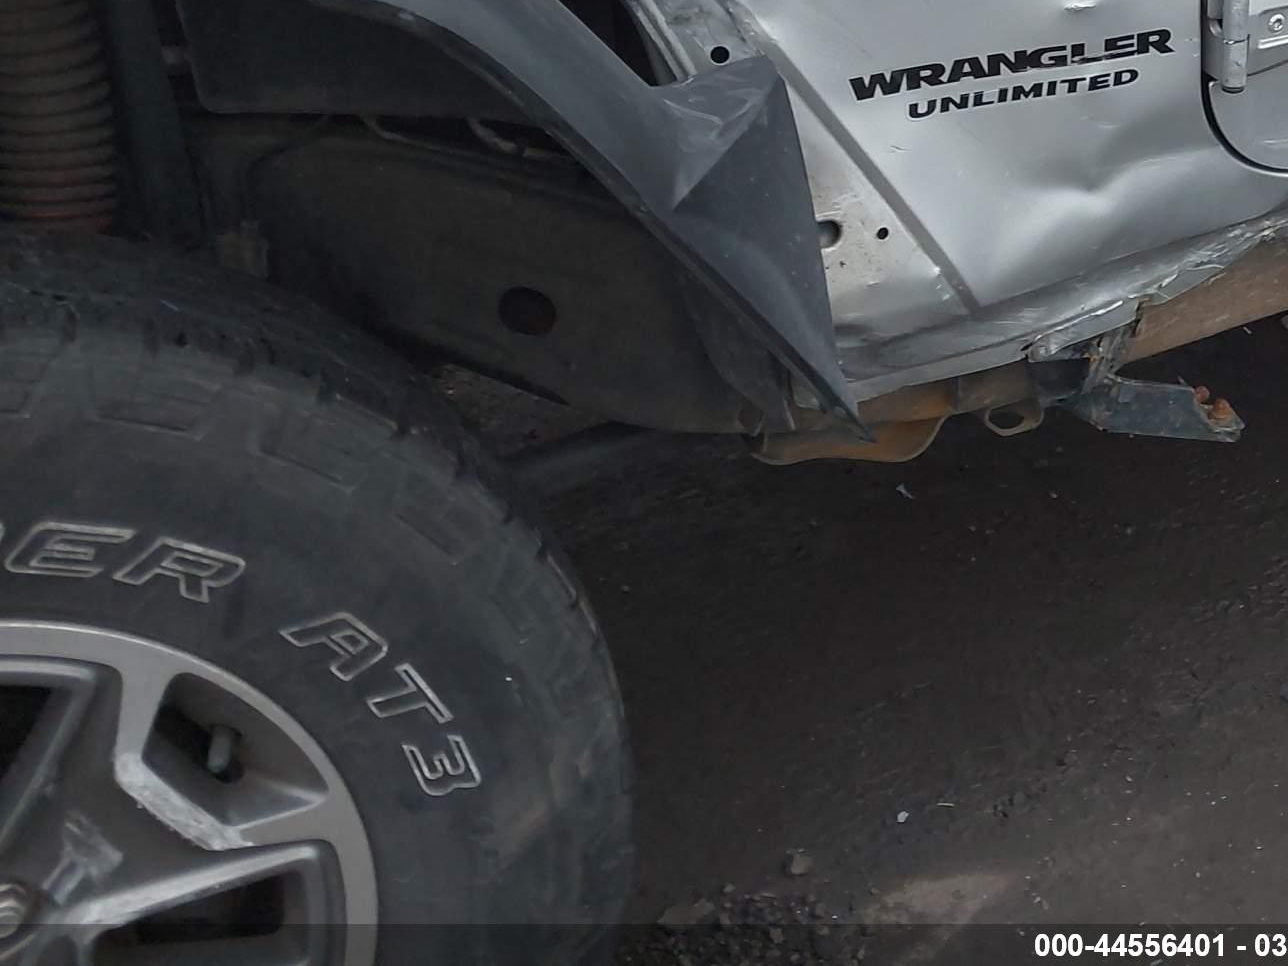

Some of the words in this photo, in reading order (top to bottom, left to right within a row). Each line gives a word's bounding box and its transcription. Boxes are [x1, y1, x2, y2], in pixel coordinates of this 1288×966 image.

[849, 29, 1175, 101] WRANGLER
[908, 68, 1139, 119] UNLIMITED
[0, 521, 247, 603] ER
[279, 611, 482, 796] AT3
